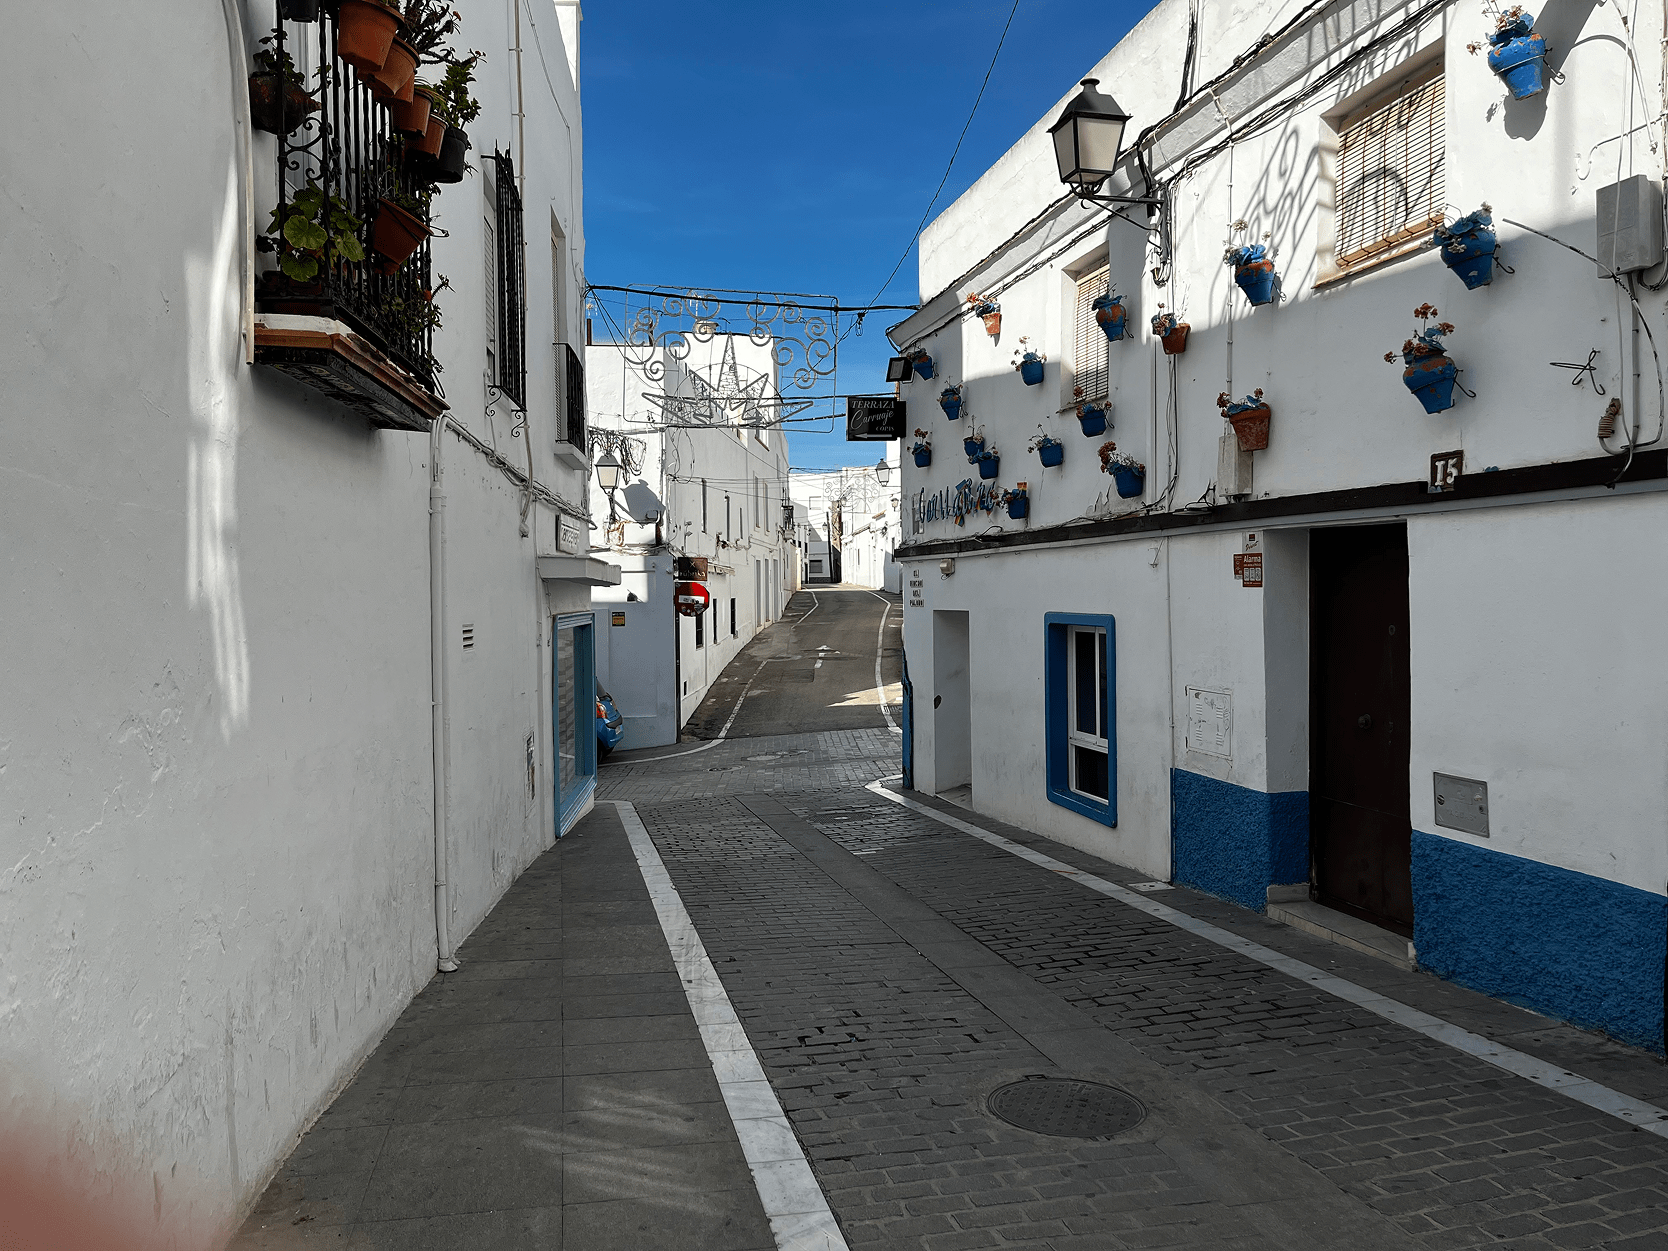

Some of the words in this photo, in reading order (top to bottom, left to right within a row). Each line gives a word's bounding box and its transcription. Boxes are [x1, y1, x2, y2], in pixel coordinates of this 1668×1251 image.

[851, 400, 895, 409] TERRAZA
[850, 409, 894, 430] Carruaje
[1435, 458, 1458, 486] 15
[1243, 554, 1261, 563] Alarma
